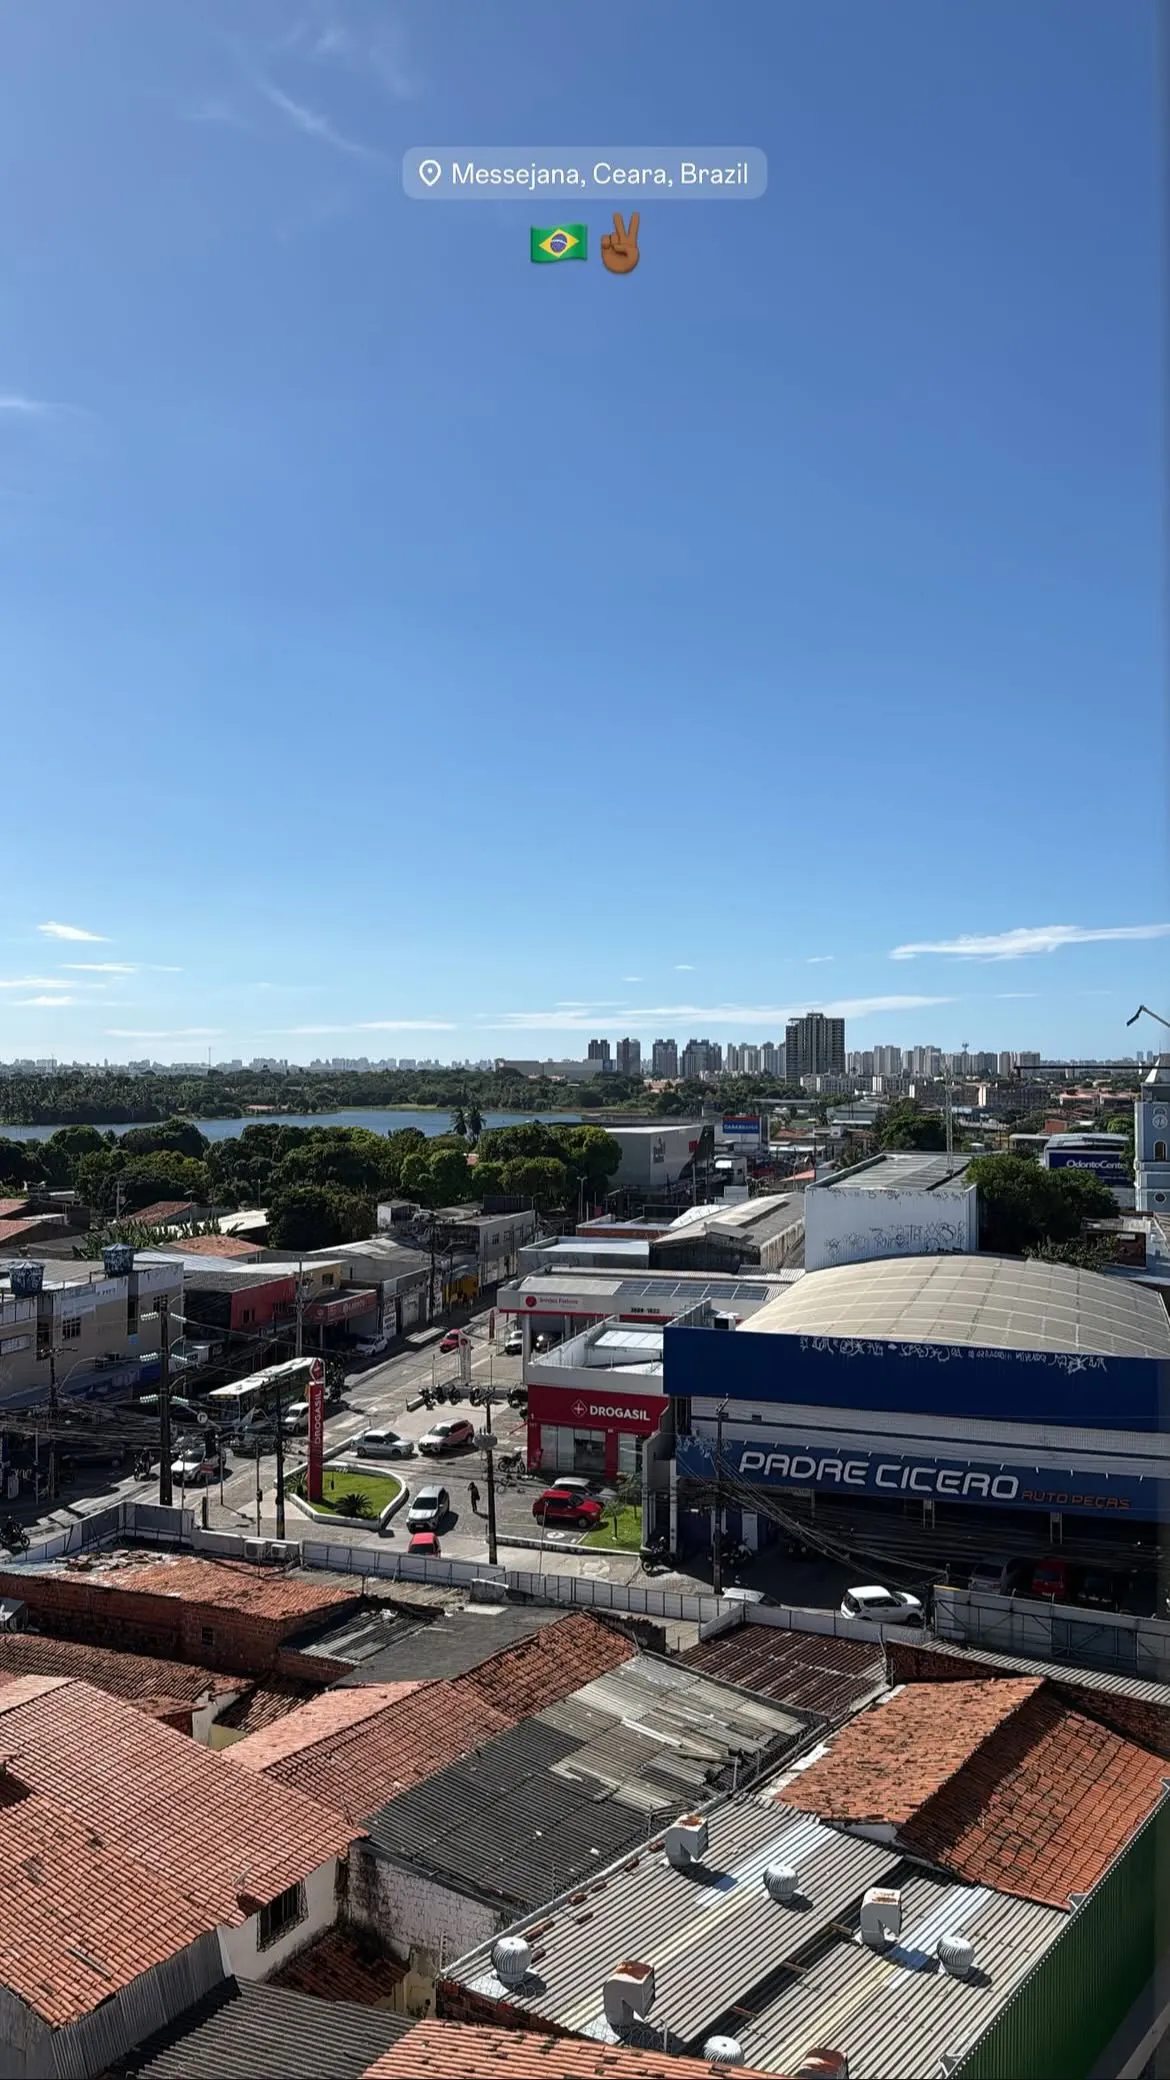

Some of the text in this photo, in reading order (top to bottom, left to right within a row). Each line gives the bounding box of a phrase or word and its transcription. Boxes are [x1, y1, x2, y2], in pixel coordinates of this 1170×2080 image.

[590, 1405, 651, 1421] DROGASIL
[739, 1451, 870, 1485] PADRE
[875, 1464, 1019, 1499] CICERO
[1022, 1490, 1068, 1504] AUTO
